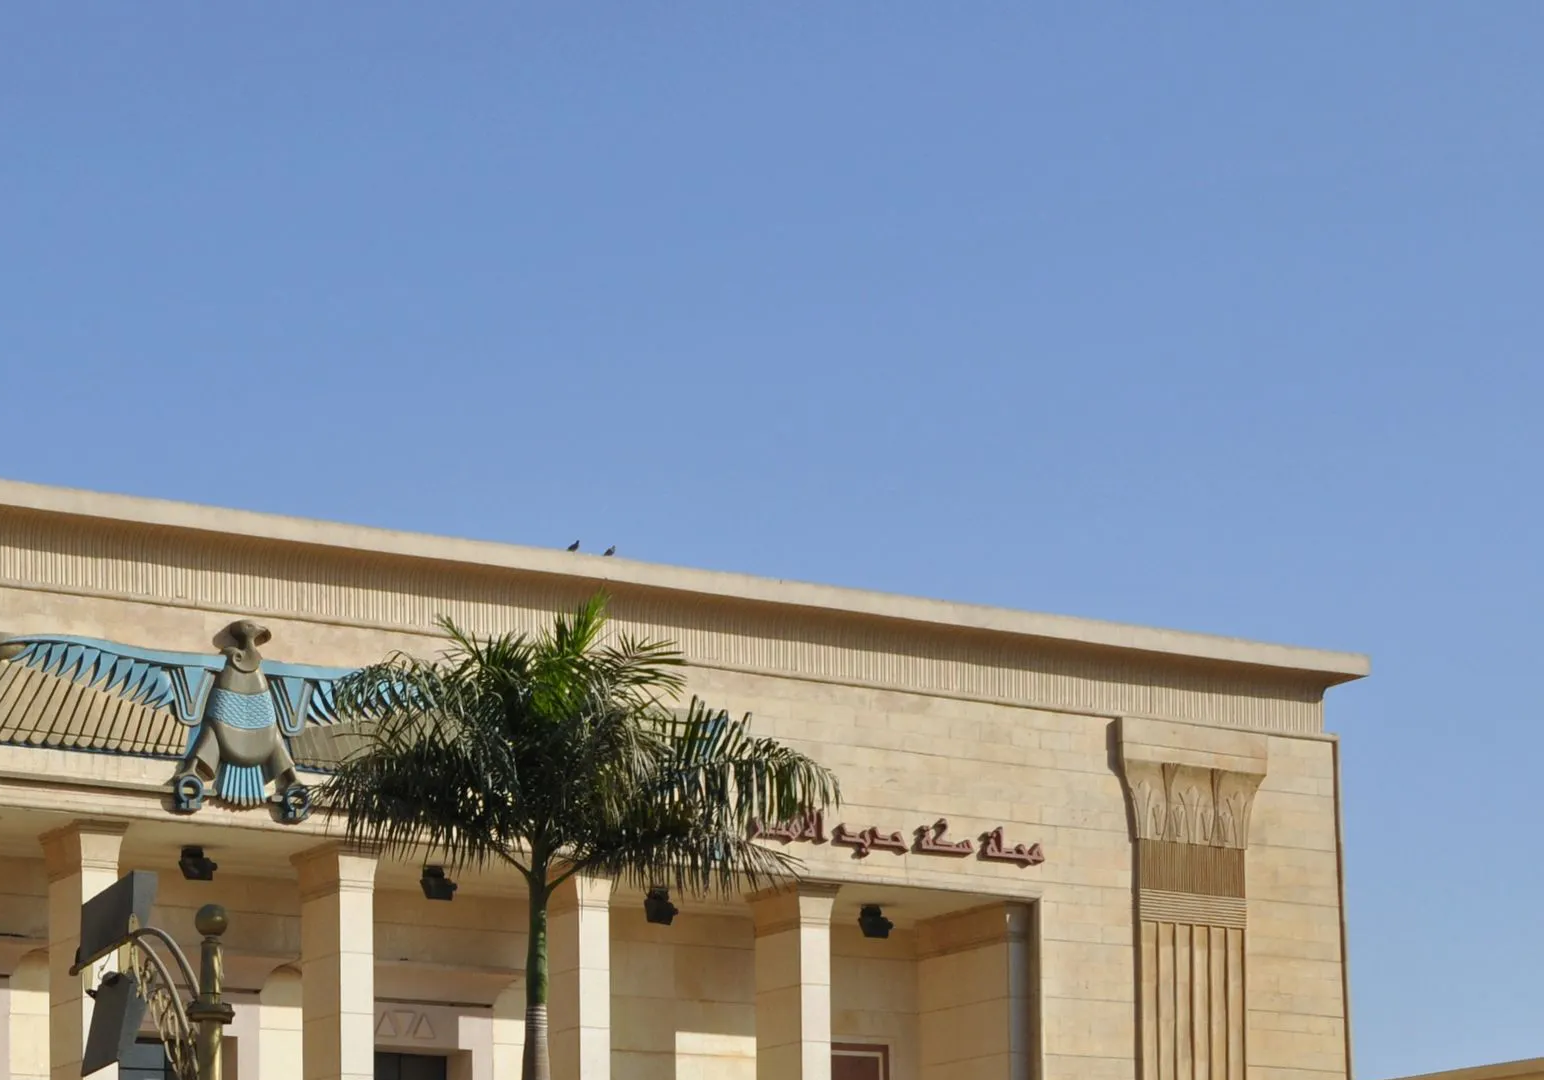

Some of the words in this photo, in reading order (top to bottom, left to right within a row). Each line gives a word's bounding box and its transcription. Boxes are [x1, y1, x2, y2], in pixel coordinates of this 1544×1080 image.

[832, 823, 909, 858] حديد
[914, 818, 974, 857] سكة
[978, 826, 1045, 866] محطة
